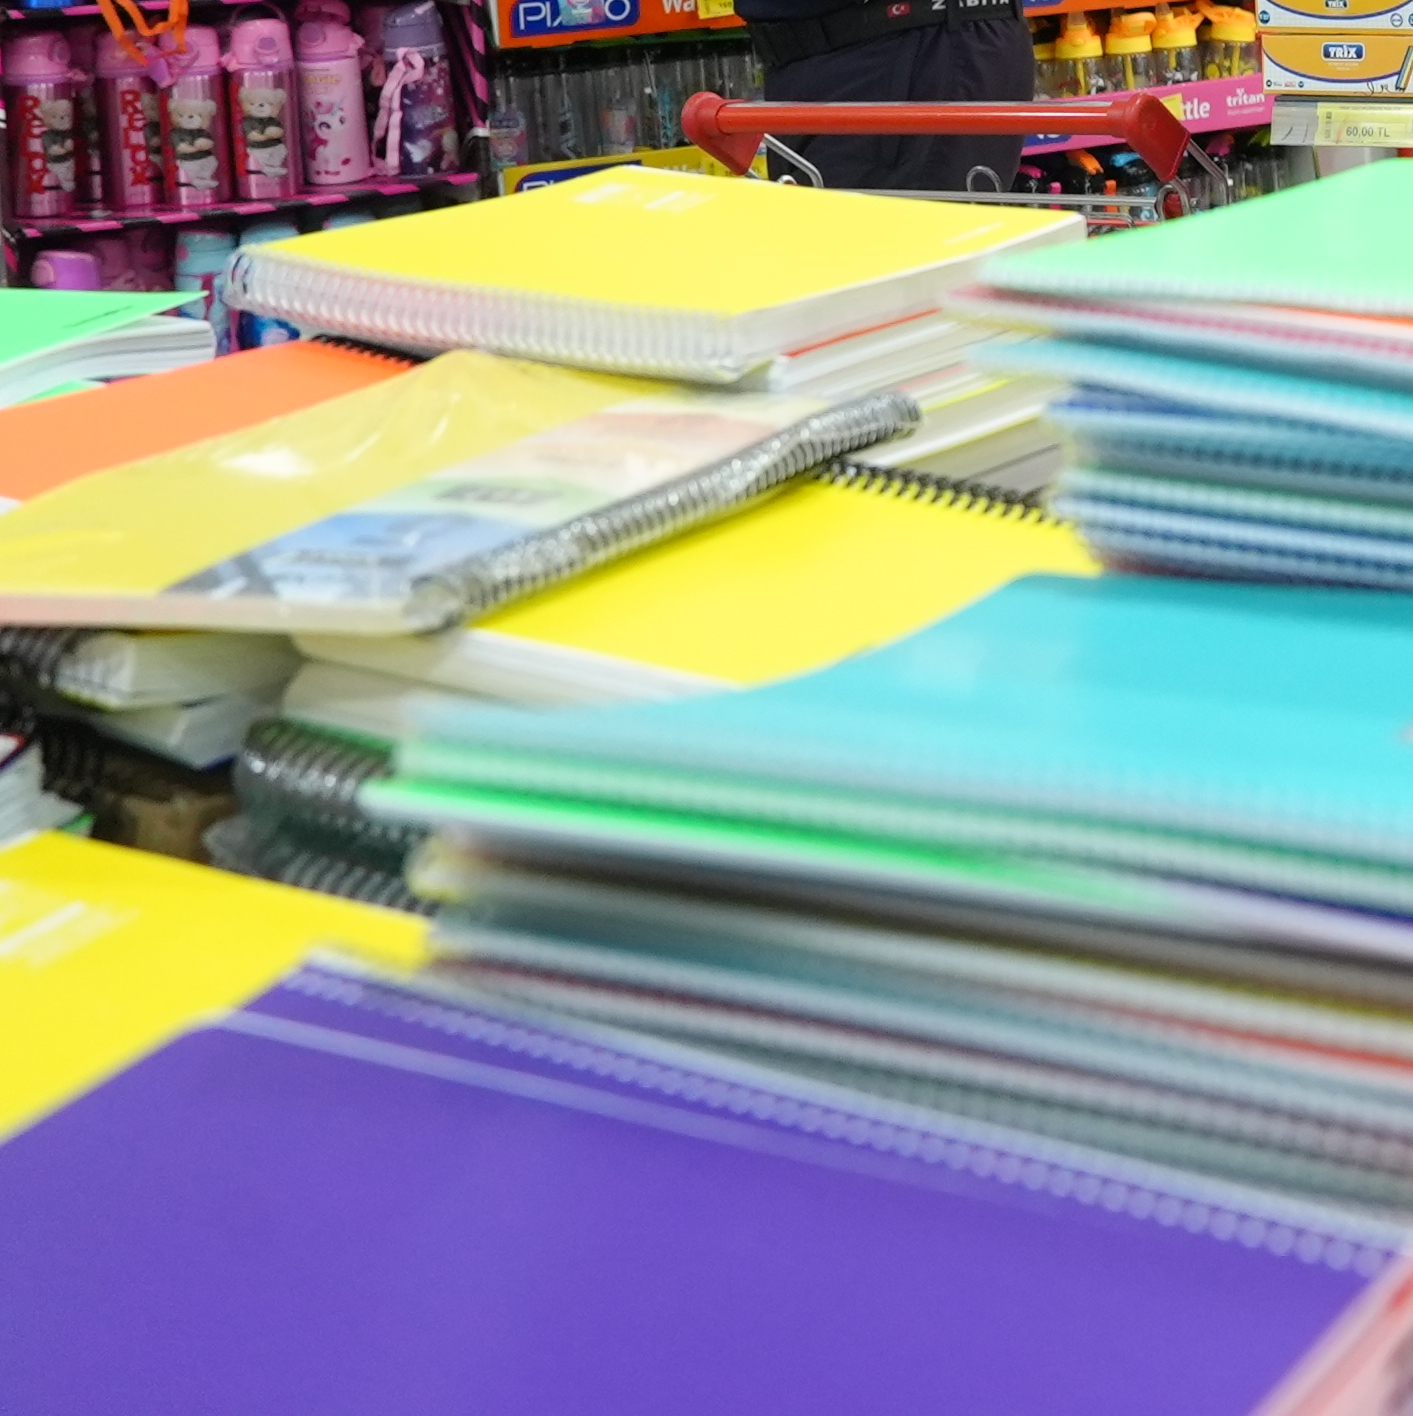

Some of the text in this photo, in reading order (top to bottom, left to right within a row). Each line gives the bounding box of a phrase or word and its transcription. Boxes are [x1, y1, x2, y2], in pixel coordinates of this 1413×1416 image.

[1226, 92, 1266, 107] tritan
[1346, 125, 1390, 138] 60,00 TL
